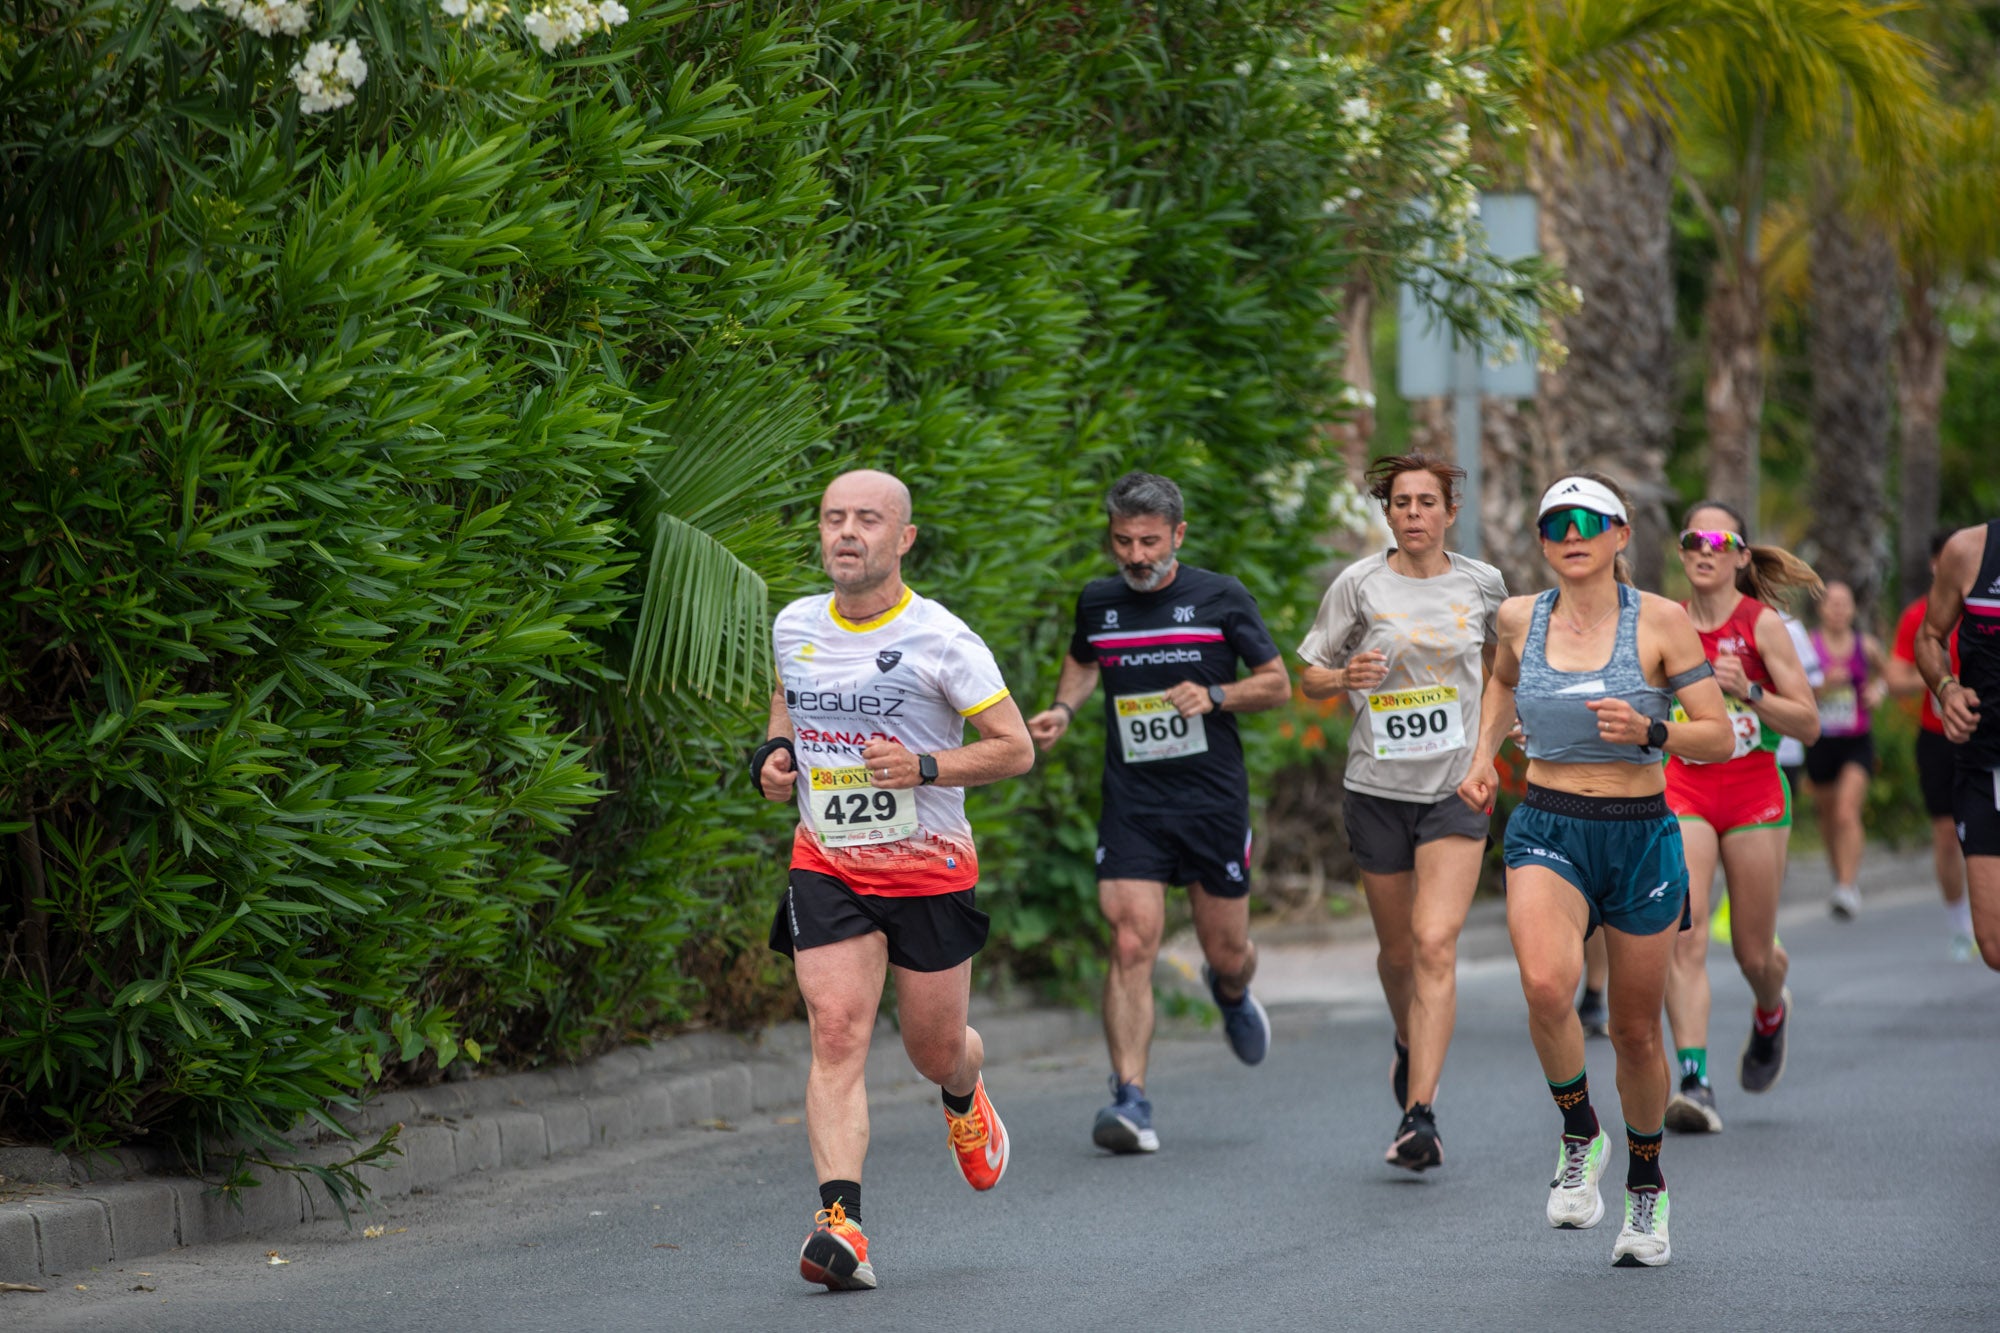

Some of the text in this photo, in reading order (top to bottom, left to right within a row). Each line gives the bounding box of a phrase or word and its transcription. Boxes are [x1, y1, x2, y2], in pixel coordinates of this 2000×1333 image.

[1131, 715, 1188, 744] 960
[1387, 709, 1447, 740] 690
[820, 771, 874, 785] 38 FOND
[824, 791, 897, 825] 429
